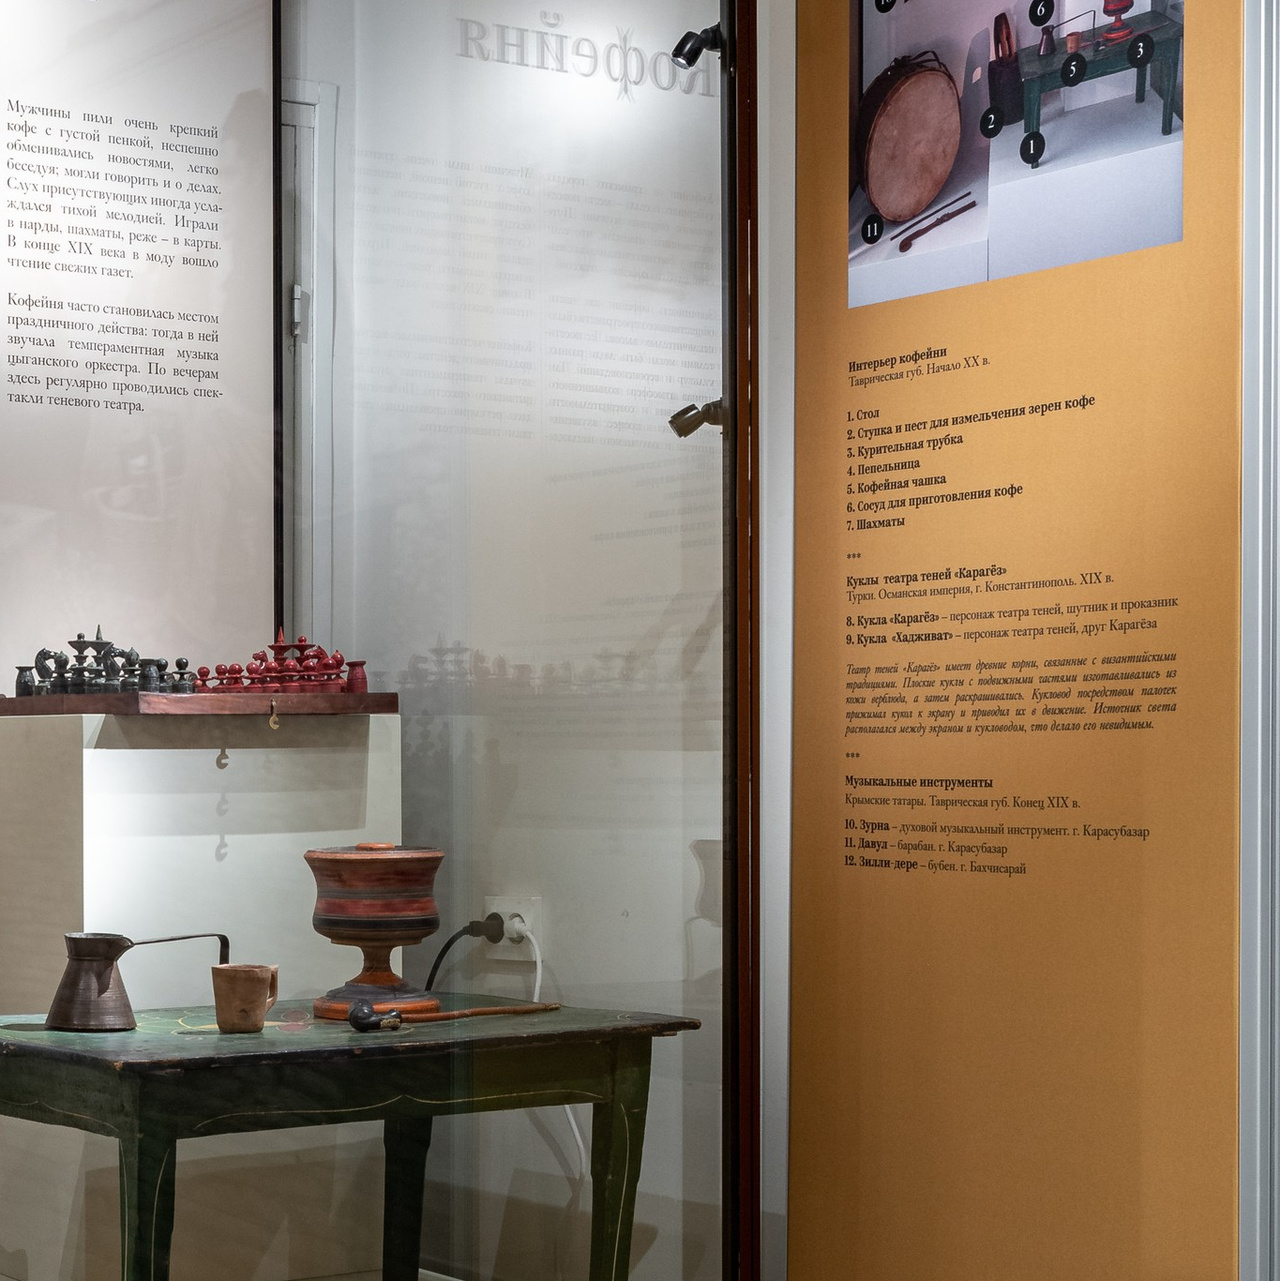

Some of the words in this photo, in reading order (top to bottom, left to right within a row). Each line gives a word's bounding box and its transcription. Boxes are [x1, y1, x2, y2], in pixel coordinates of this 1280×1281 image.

[6, 98, 71, 120] Мужчины
[82, 112, 113, 125] пили
[123, 118, 159, 131] очень
[169, 124, 218, 140] крепкий
[6, 176, 39, 192] Слух
[42, 184, 148, 206] присутствующих
[150, 196, 191, 211] иногда
[193, 201, 223, 215] усла-
[867, 222, 879, 238] 11
[7, 257, 52, 271] чтение
[54, 262, 98, 275] свежих
[101, 267, 134, 279] газет.
[7, 292, 64, 312] Кофейня
[67, 301, 101, 313] часто
[102, 305, 175, 320] становилась
[177, 311, 219, 325] местом
[7, 315, 95, 332] праздничного
[97, 321, 148, 337] действа:
[151, 328, 184, 341] тогда
[187, 331, 197, 341] в
[197, 329, 219, 343] ней
[847, 371, 905, 389] Таврическая
[905, 365, 924, 382] губ.
[926, 361, 962, 375] Начало
[963, 354, 980, 369] XX
[982, 357, 991, 366] в.
[848, 356, 898, 373] Интерьер
[898, 346, 948, 365] кофейни
[6, 392, 44, 405] такли
[46, 393, 101, 409] теневого
[102, 399, 145, 416] театра.
[846, 410, 855, 423] 1.
[856, 408, 880, 421] Стол
[846, 428, 856, 441] 2.
[857, 425, 894, 441] Ступка
[894, 424, 903, 434] и
[904, 420, 929, 433] пест
[928, 417, 950, 431] для
[951, 406, 1027, 426] измельчения
[1028, 401, 1062, 417] зерен
[1064, 393, 1096, 410] кофе
[846, 447, 856, 459] 3.
[857, 439, 925, 460] Курительная
[925, 433, 964, 451] трубка
[846, 465, 856, 477] 4.
[857, 459, 921, 476] Пепельница
[846, 482, 856, 495] 5.
[857, 478, 910, 495] Кофейная
[911, 475, 948, 488] чашка
[846, 501, 856, 513] 6.
[856, 500, 887, 514] Сосуд
[886, 498, 907, 511] для
[908, 488, 992, 510] приготовления
[993, 482, 1024, 499] кофе
[846, 519, 855, 532] 7.
[856, 517, 906, 531] Шахматы
[845, 590, 876, 605] Турки.
[878, 587, 928, 600] Османская
[929, 585, 974, 599] империя,
[975, 584, 983, 594] г.
[985, 577, 1077, 593] Константинополь.
[1079, 571, 1103, 586] XIX
[1104, 574, 1115, 584] в.
[846, 575, 880, 591] Куклы
[882, 573, 919, 587] театра
[919, 567, 952, 582] теней
[845, 615, 856, 628] 8.
[856, 614, 888, 630] Кукла
[949, 610, 996, 625] персонаж
[996, 608, 1030, 622] театра
[1031, 602, 1064, 617] теней,
[1066, 602, 1109, 618] шутник
[1110, 602, 1119, 611] и
[1120, 597, 1179, 614] проказник
[845, 633, 855, 646] 9.
[856, 633, 888, 648] Кукла
[963, 629, 1010, 644] персонаж
[1011, 627, 1045, 641] театра
[1045, 621, 1080, 636] теней,
[1080, 623, 1107, 637] друг
[1109, 618, 1158, 635] Карагёза
[844, 774, 918, 790] Музыкальные
[919, 778, 994, 792] инструменты
[844, 792, 891, 809] Крымские
[891, 797, 927, 811] татары.
[928, 794, 989, 811] Таврическая
[990, 796, 1011, 812] губ.
[1012, 795, 1046, 811] Конец
[1046, 795, 1070, 809] XIX
[1071, 799, 1081, 809] в.
[844, 818, 858, 830] 10.
[859, 818, 891, 834] Зурна
[898, 821, 938, 836] духовой
[939, 822, 1005, 837] музыкальный
[1006, 826, 1070, 840] инструмент.
[1072, 827, 1080, 837] г.
[1082, 823, 1151, 842] Карасубазар
[844, 836, 857, 849] 11.
[857, 837, 888, 853] Давул
[897, 839, 937, 855] барабан.
[938, 843, 946, 852] г.
[947, 840, 1008, 858] Карасубазар
[843, 854, 858, 867] 12.
[858, 855, 919, 873] Зилли-дере
[927, 859, 959, 875] бубен.
[960, 863, 968, 872] г.
[969, 860, 1027, 879] Бахчисарай
